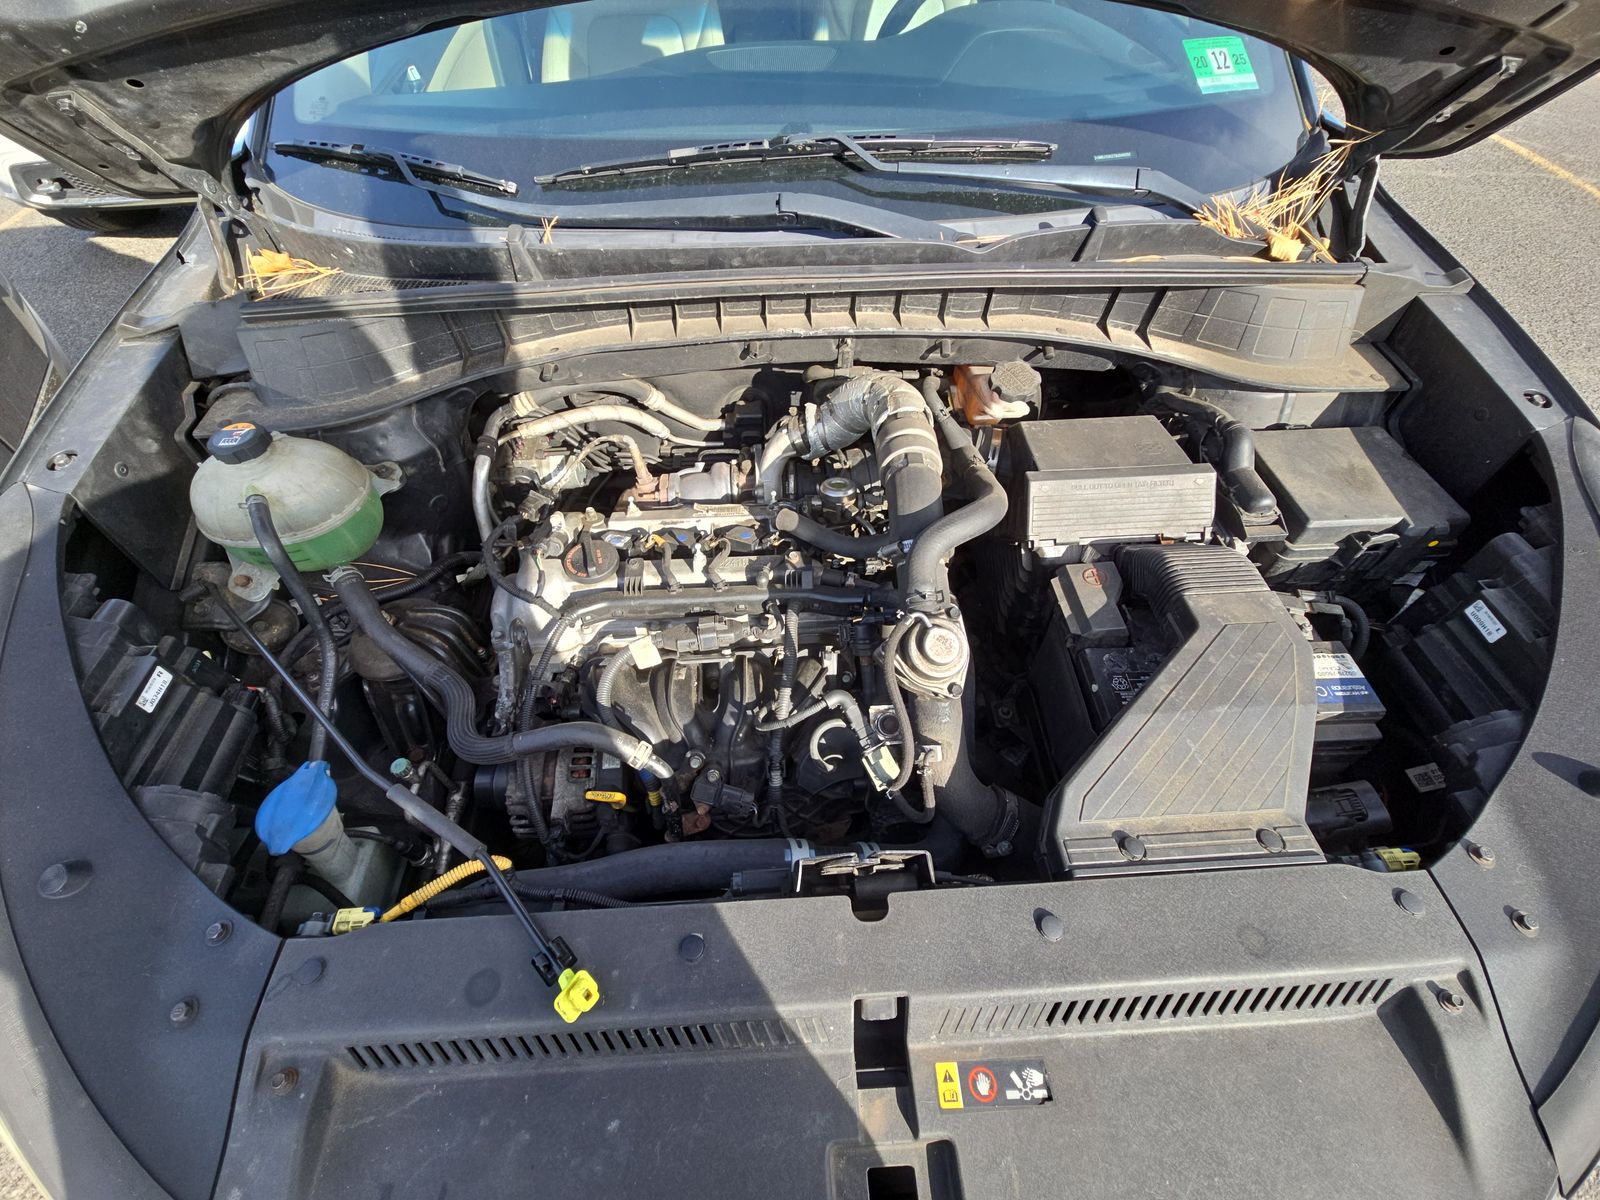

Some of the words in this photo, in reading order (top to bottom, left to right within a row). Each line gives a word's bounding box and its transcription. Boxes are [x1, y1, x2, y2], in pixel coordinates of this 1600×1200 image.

[1193, 56, 1208, 69] 20
[1211, 50, 1231, 70] 12
[1232, 53, 1247, 65] 25
